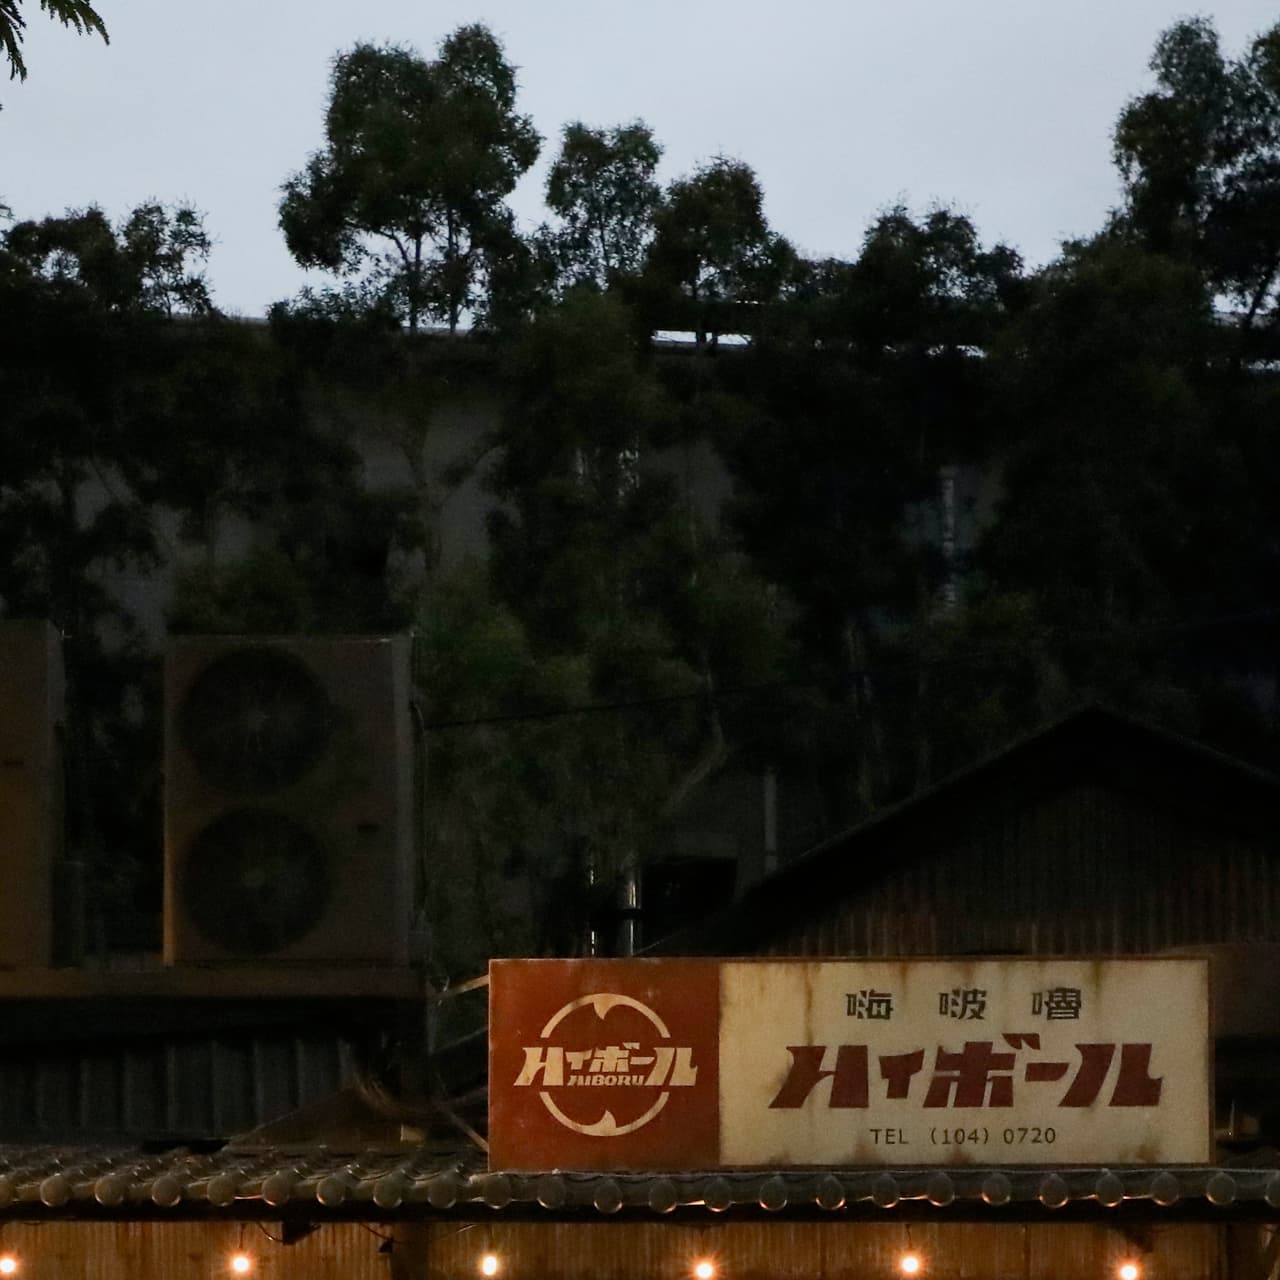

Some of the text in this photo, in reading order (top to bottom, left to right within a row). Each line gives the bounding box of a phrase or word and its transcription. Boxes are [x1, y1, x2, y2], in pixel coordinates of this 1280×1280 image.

[513, 1042, 698, 1086] ハイボール
[768, 1033, 1166, 1109] ハイボール
[567, 1074, 645, 1086] HIBORU
[870, 1127, 1057, 1145] TEL (104) 0720
